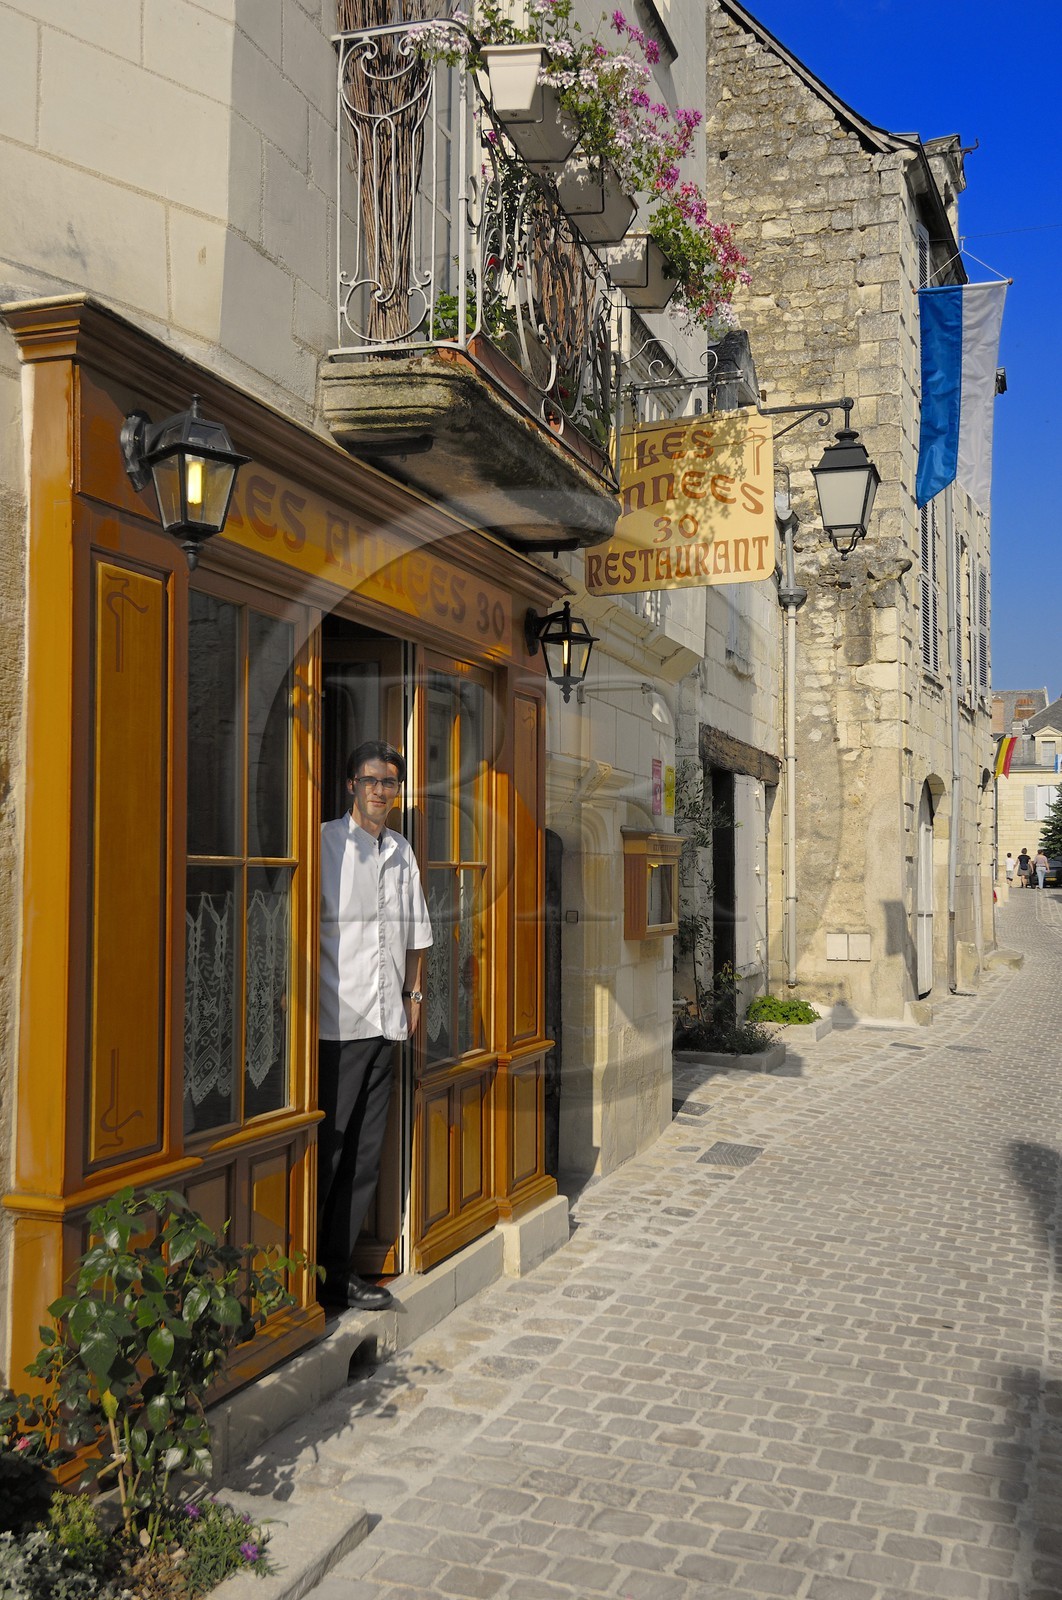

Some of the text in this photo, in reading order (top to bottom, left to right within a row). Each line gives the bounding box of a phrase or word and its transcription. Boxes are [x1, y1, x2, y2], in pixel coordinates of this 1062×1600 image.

[636, 429, 715, 470] LES
[621, 470, 765, 518] NNEES
[653, 513, 699, 544] 30
[324, 511, 467, 624] ANNEES
[476, 591, 505, 641] 30
[587, 535, 769, 588] RESTAURANT
